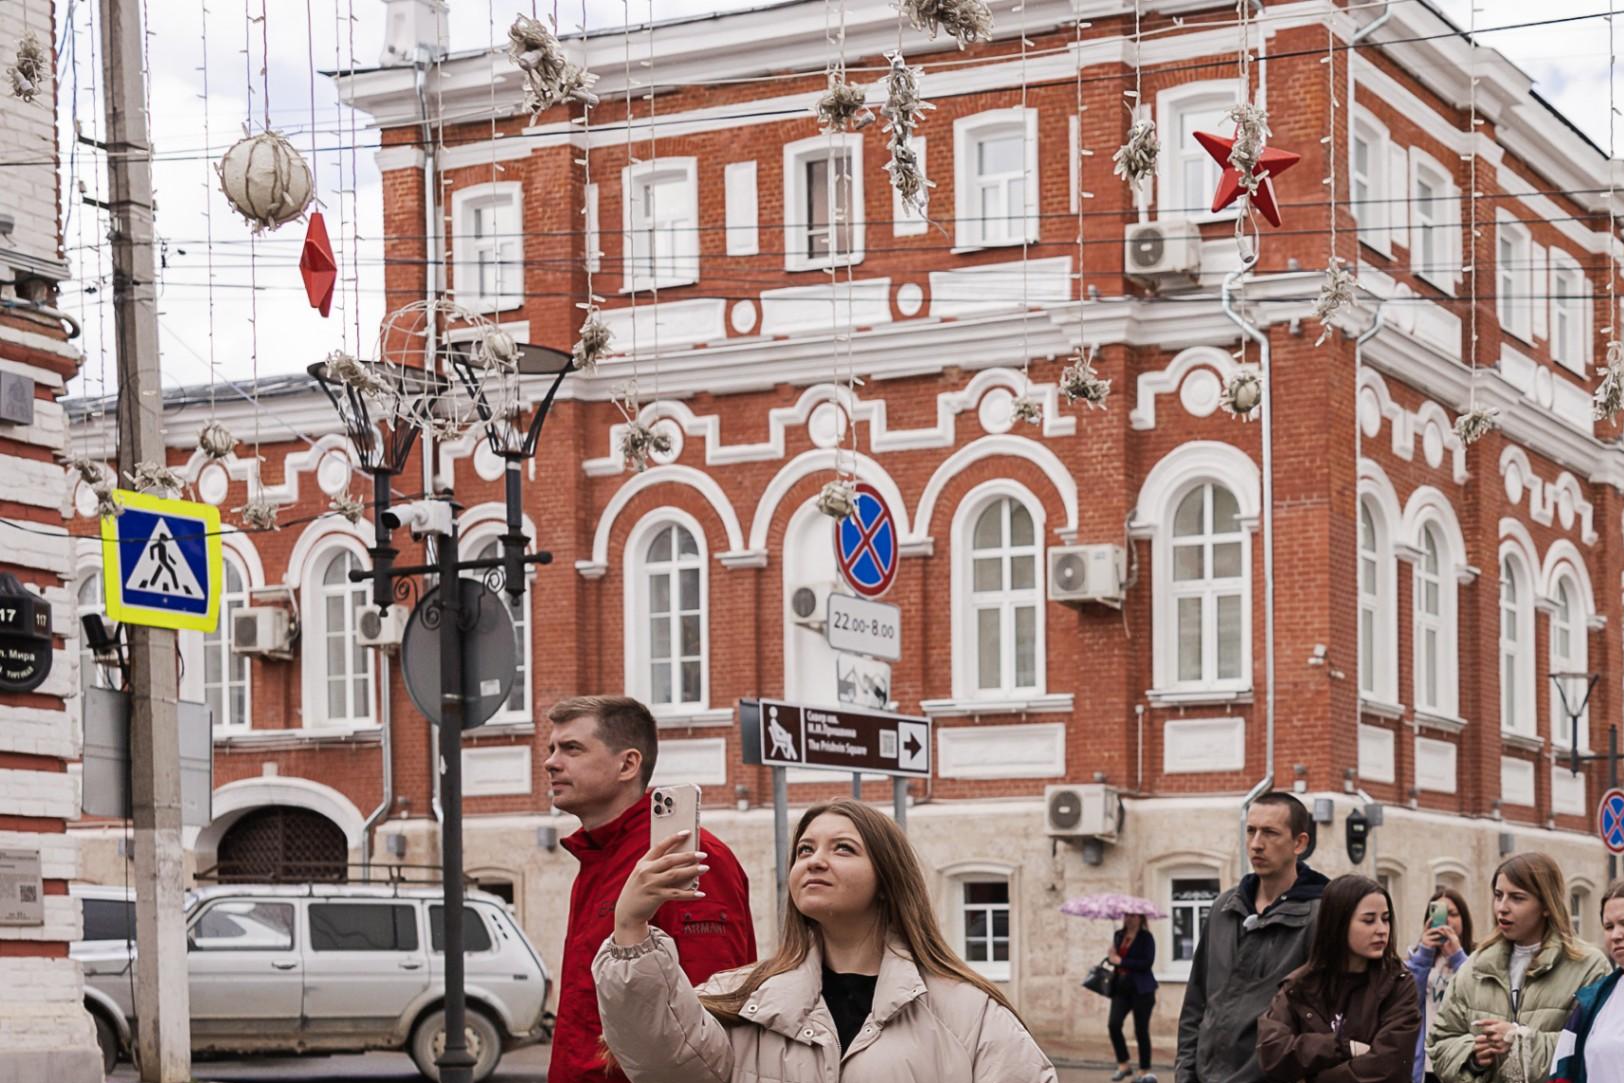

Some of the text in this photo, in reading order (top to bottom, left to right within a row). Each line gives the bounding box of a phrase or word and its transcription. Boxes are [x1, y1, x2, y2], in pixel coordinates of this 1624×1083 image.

[834, 611, 894, 639] 22.00-8.00
[9, 649, 35, 662] Мира
[808, 738, 820, 751] The
[846, 742, 868, 756] Square
[684, 922, 727, 934] ARMANI
